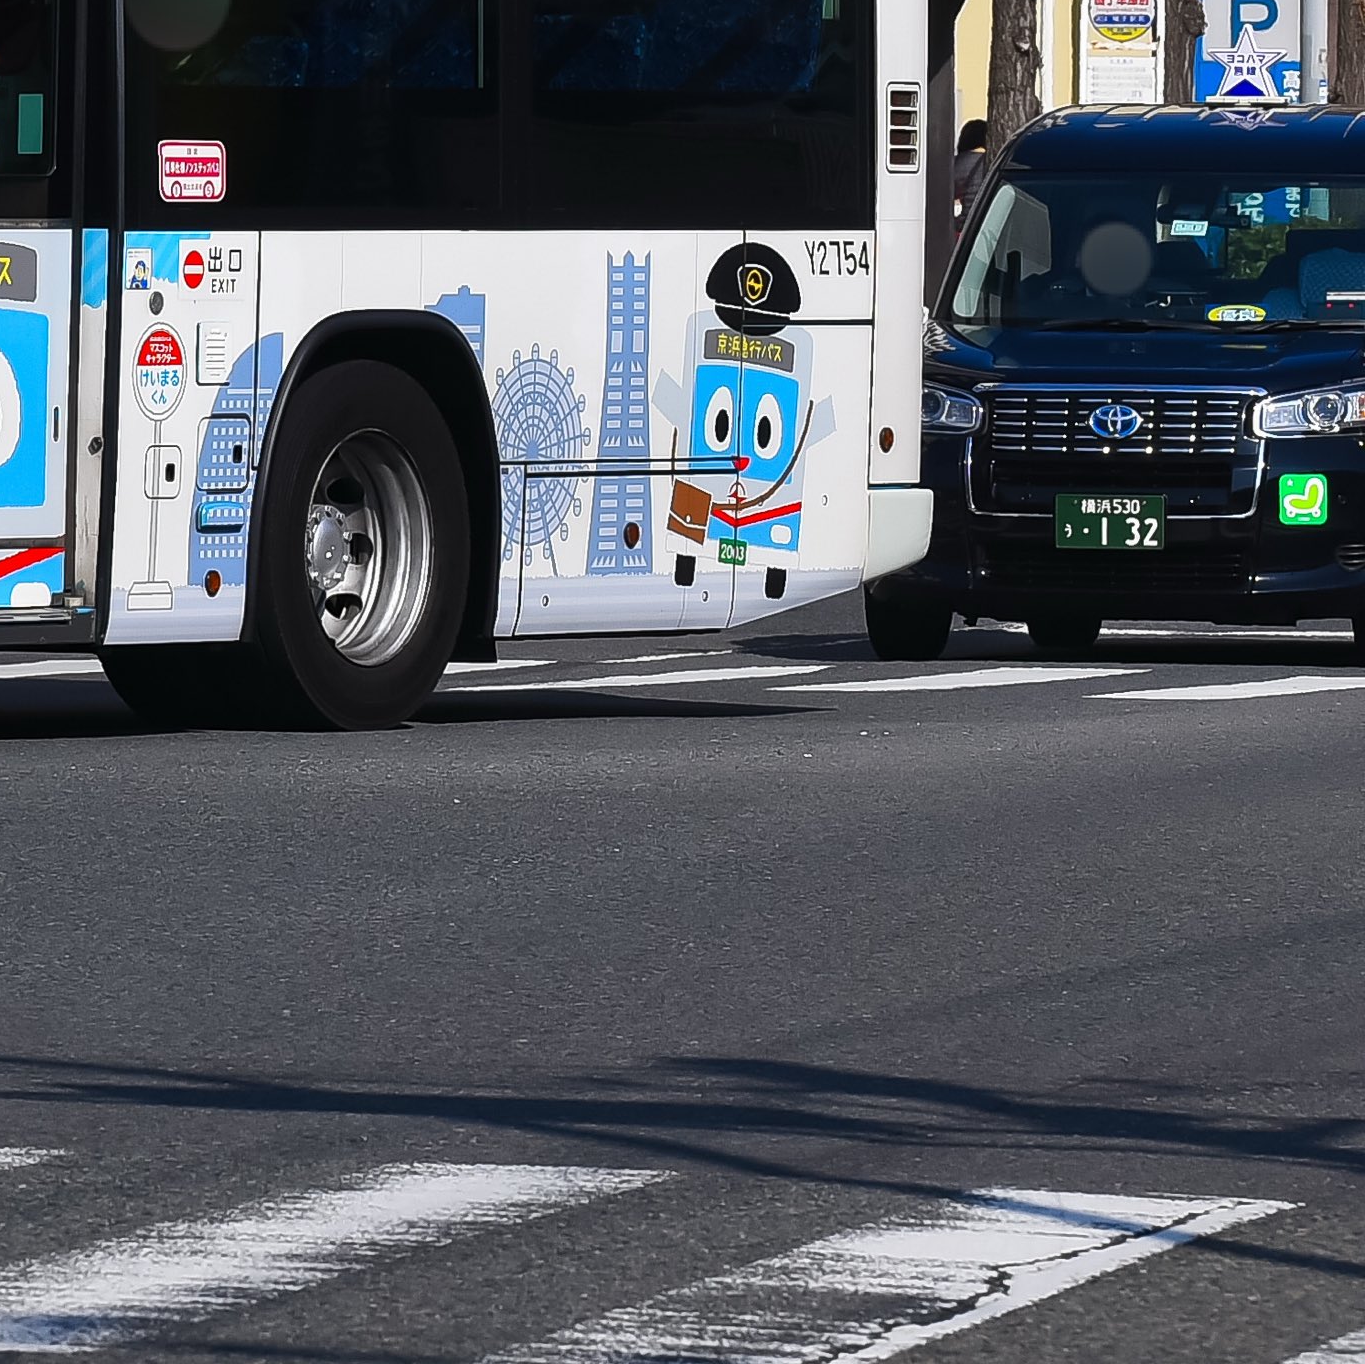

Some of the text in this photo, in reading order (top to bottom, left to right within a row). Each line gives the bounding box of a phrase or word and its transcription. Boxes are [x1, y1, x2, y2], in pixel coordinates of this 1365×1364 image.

[1227, 54, 1266, 64] ヨコハマ
[1234, 66, 1257, 76] 無線
[208, 246, 242, 272] 出口
[804, 240, 870, 276] Y2754
[211, 279, 236, 293] EXIT
[717, 333, 783, 362] 京浜急行バス
[140, 369, 179, 387] けいまる
[151, 389, 167, 405] くん
[1081, 499, 1141, 514] 横浜530
